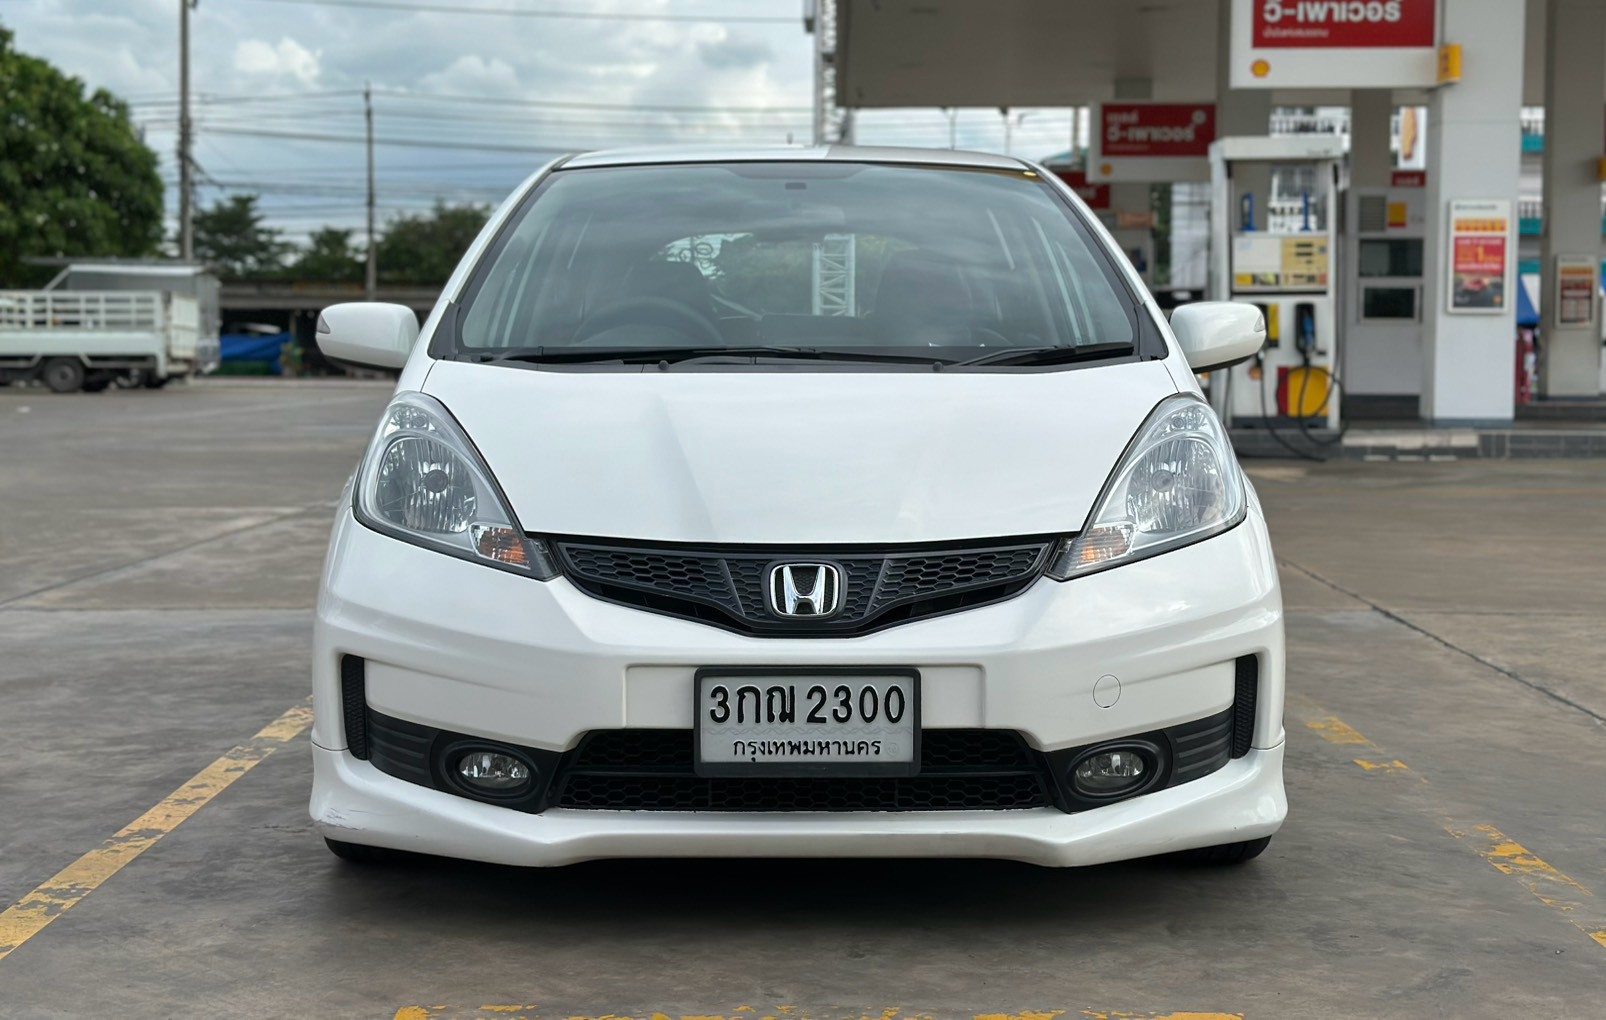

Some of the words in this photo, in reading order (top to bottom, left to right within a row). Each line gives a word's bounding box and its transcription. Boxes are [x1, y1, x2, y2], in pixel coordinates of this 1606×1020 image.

[1263, 0, 1402, 23] ว-เพาเวอร
[709, 685, 795, 724] 3กฌ
[806, 685, 905, 724] 2300
[733, 740, 882, 763] กรุงเทพมหานคร
